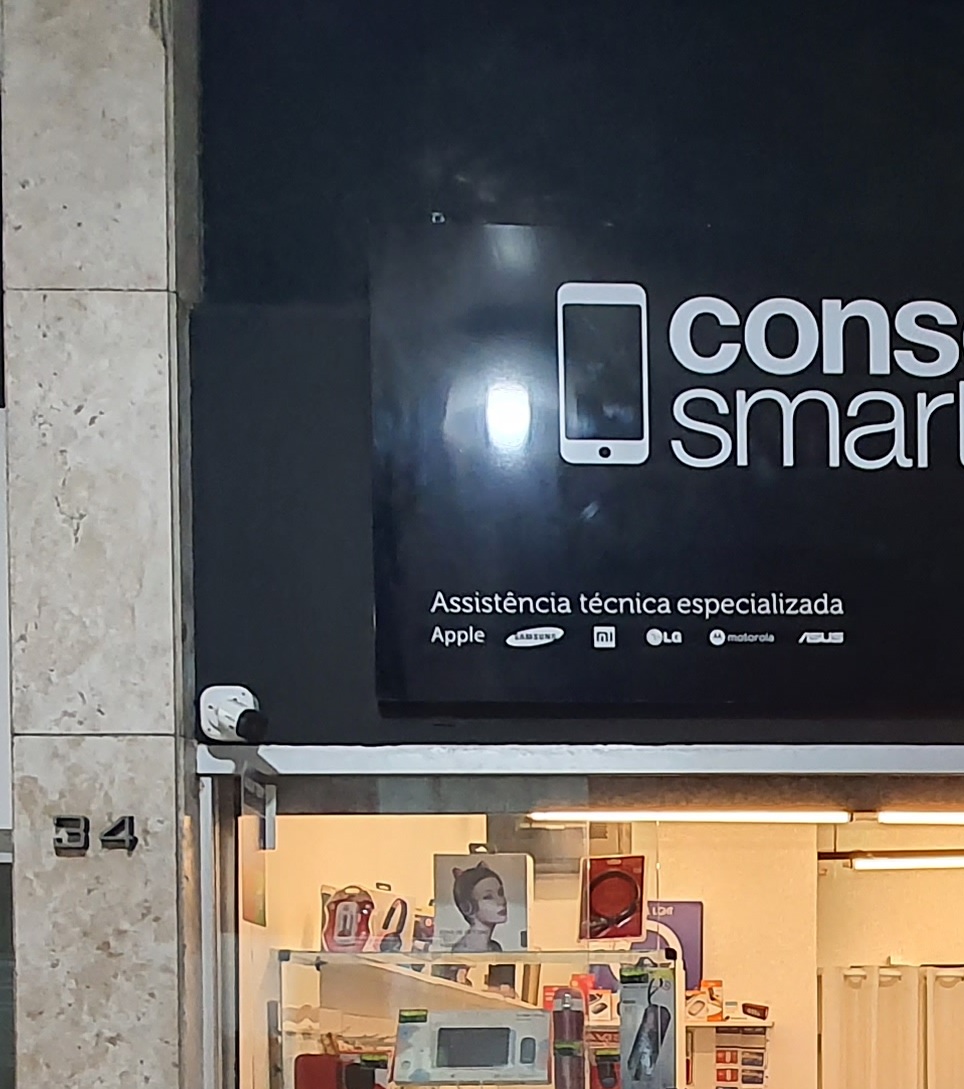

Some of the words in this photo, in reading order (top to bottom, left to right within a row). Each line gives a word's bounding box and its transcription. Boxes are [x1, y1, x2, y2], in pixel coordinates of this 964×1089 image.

[430, 592, 572, 615] Assistência
[580, 591, 671, 615] técnica
[677, 593, 844, 619] especializada
[431, 626, 486, 646] Apple
[663, 631, 682, 643] LG
[727, 633, 775, 643] motorola
[54, 815, 138, 857] 34
